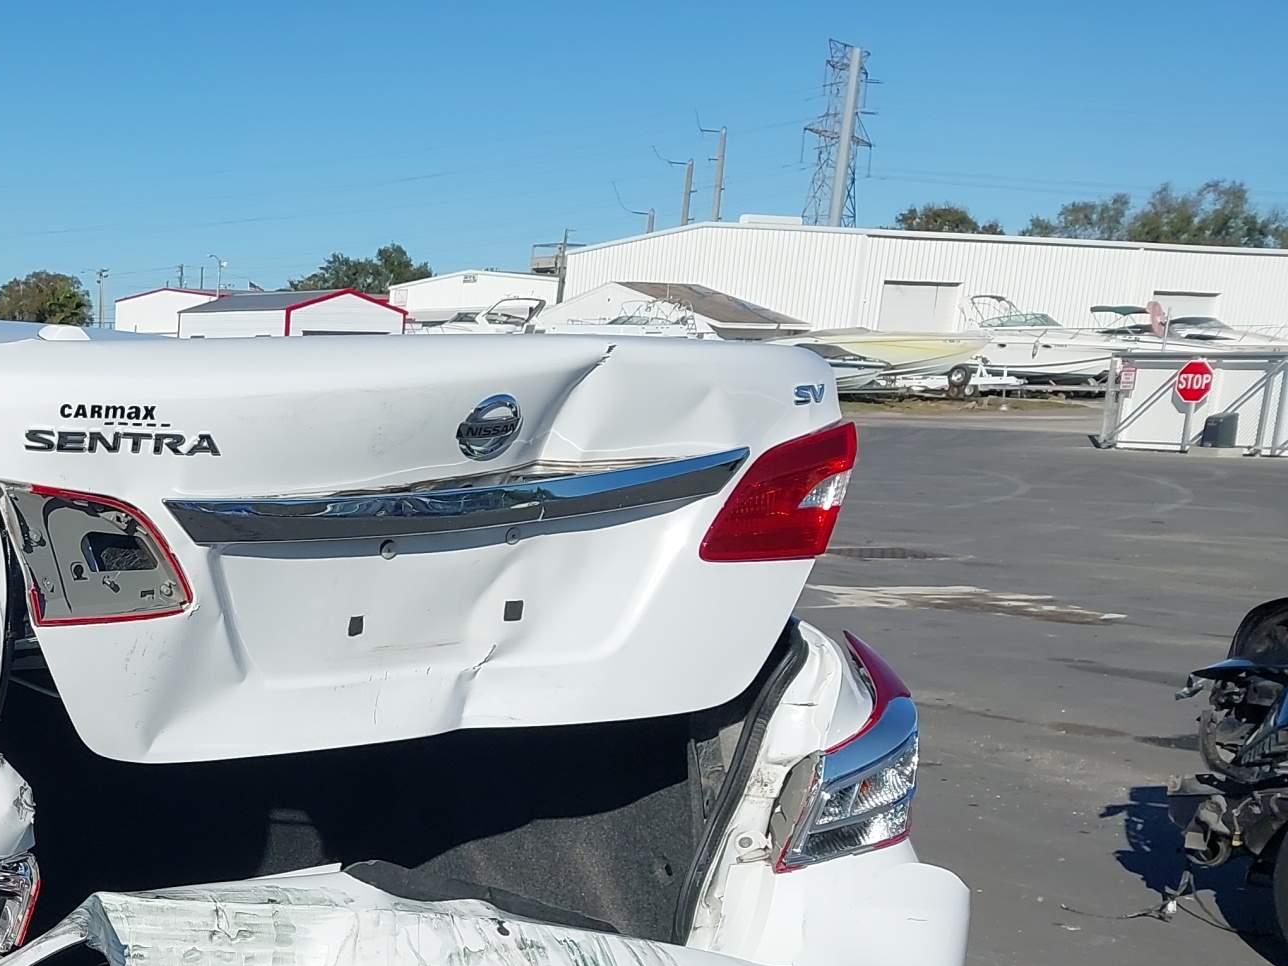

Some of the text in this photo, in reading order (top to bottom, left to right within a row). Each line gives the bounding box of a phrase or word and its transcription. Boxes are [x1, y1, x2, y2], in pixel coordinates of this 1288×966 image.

[1178, 373, 1211, 390] STOP
[794, 384, 824, 405] SV
[467, 423, 515, 436] NISSAN
[24, 430, 221, 456] SENTRA
